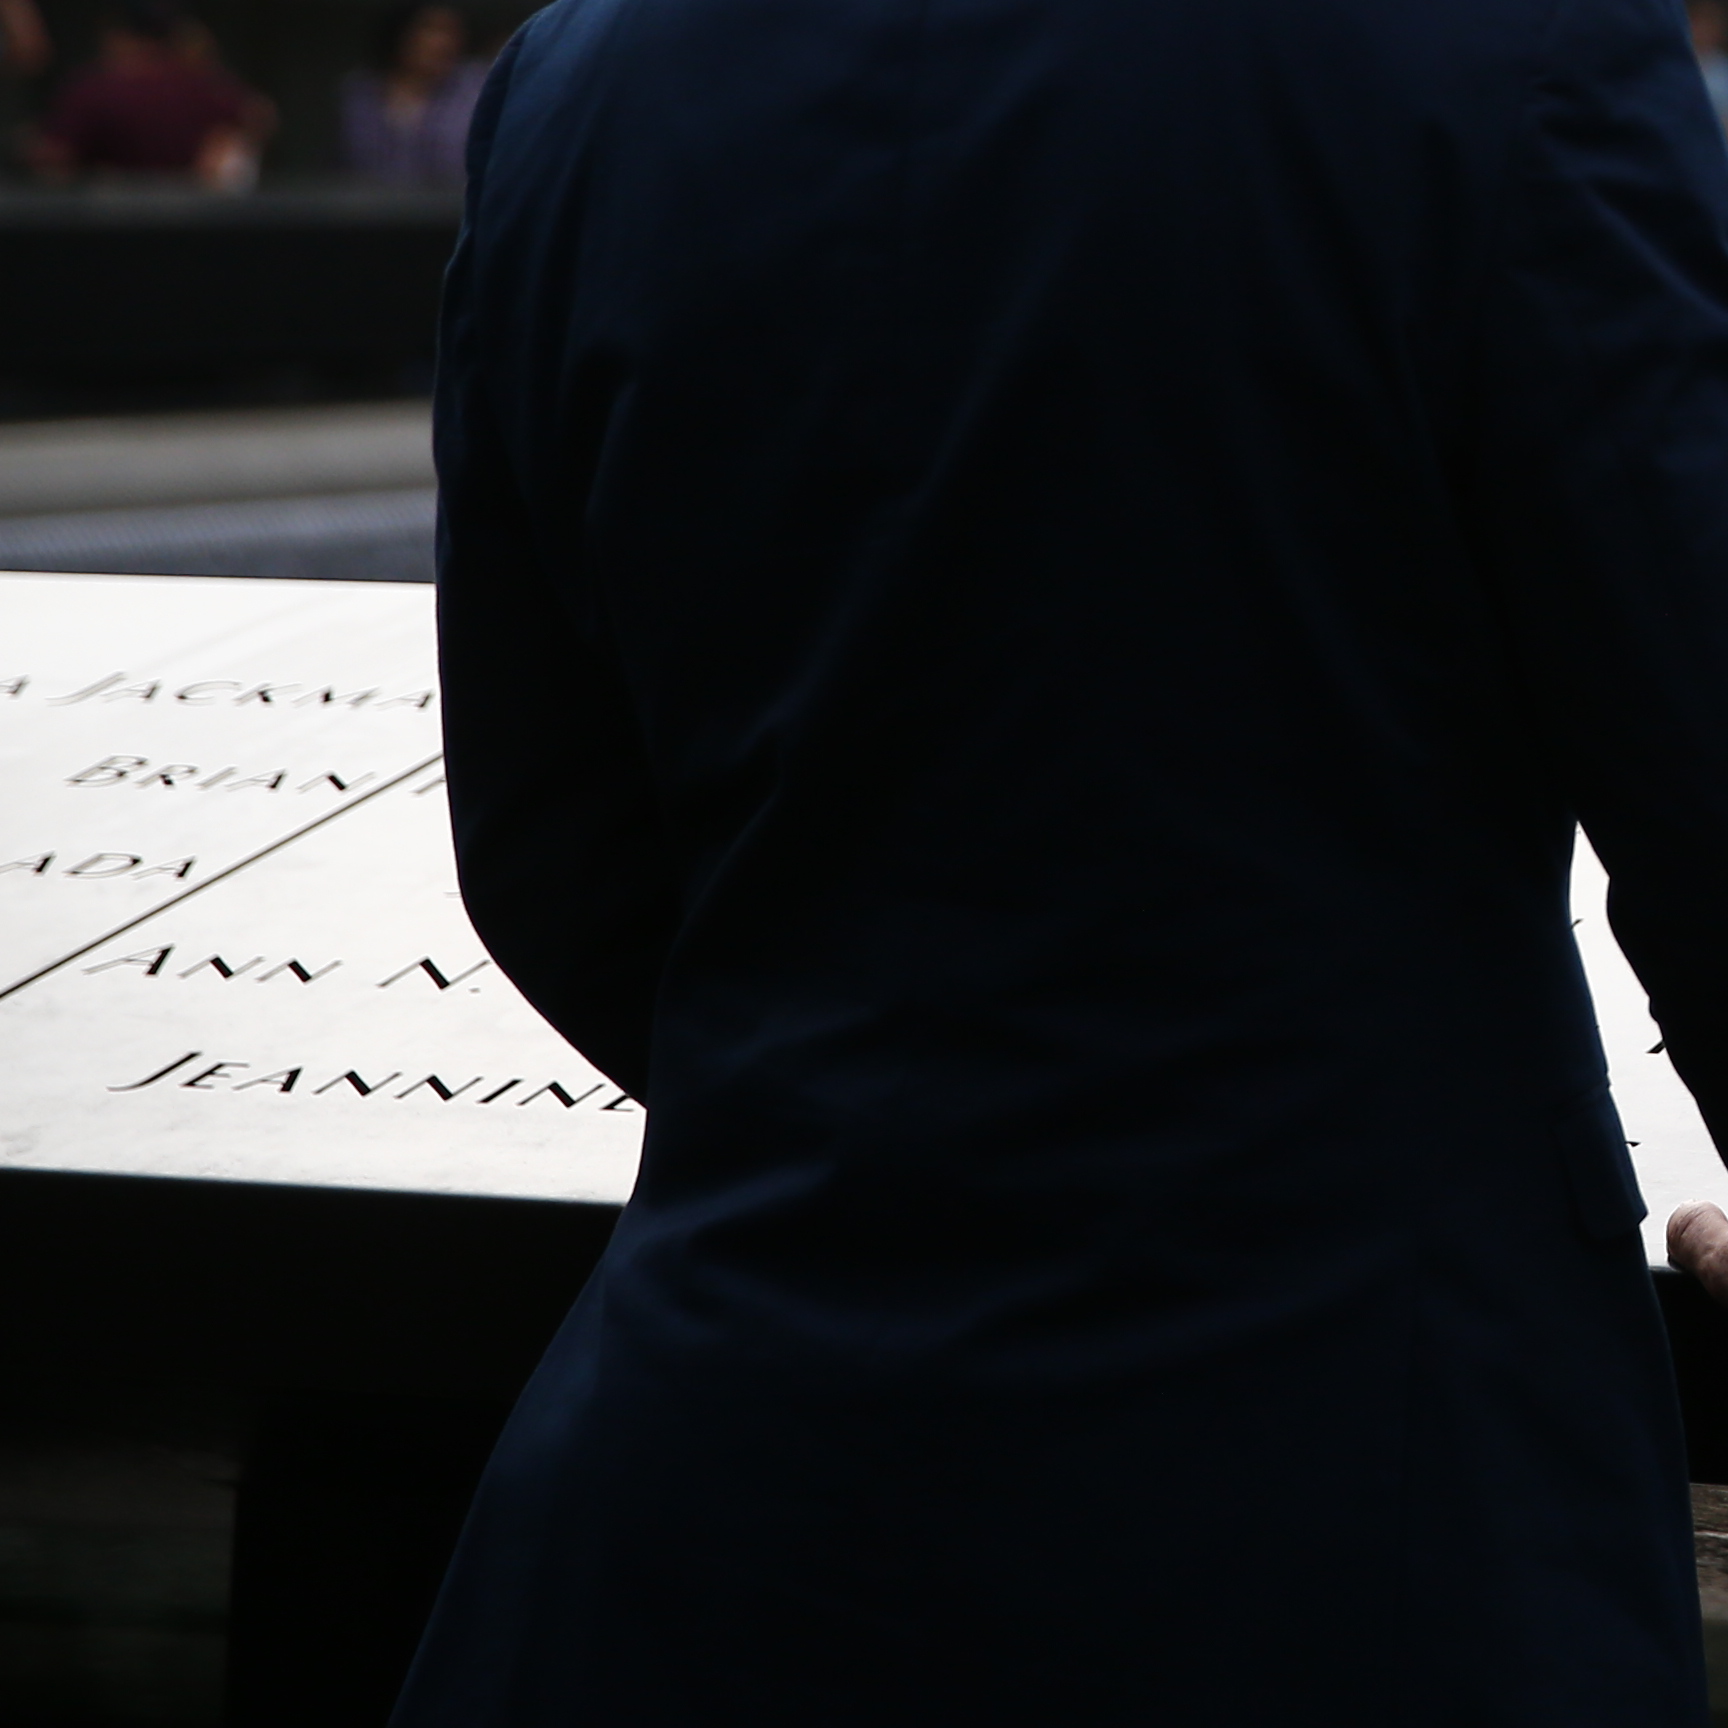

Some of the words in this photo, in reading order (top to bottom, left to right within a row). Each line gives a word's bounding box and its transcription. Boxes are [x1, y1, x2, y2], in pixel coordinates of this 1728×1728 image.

[0, 673, 31, 700] A
[45, 671, 436, 709] JACKMA
[63, 754, 377, 791] BRIAN
[0, 848, 197, 880] ADA
[82, 943, 343, 982] ANN
